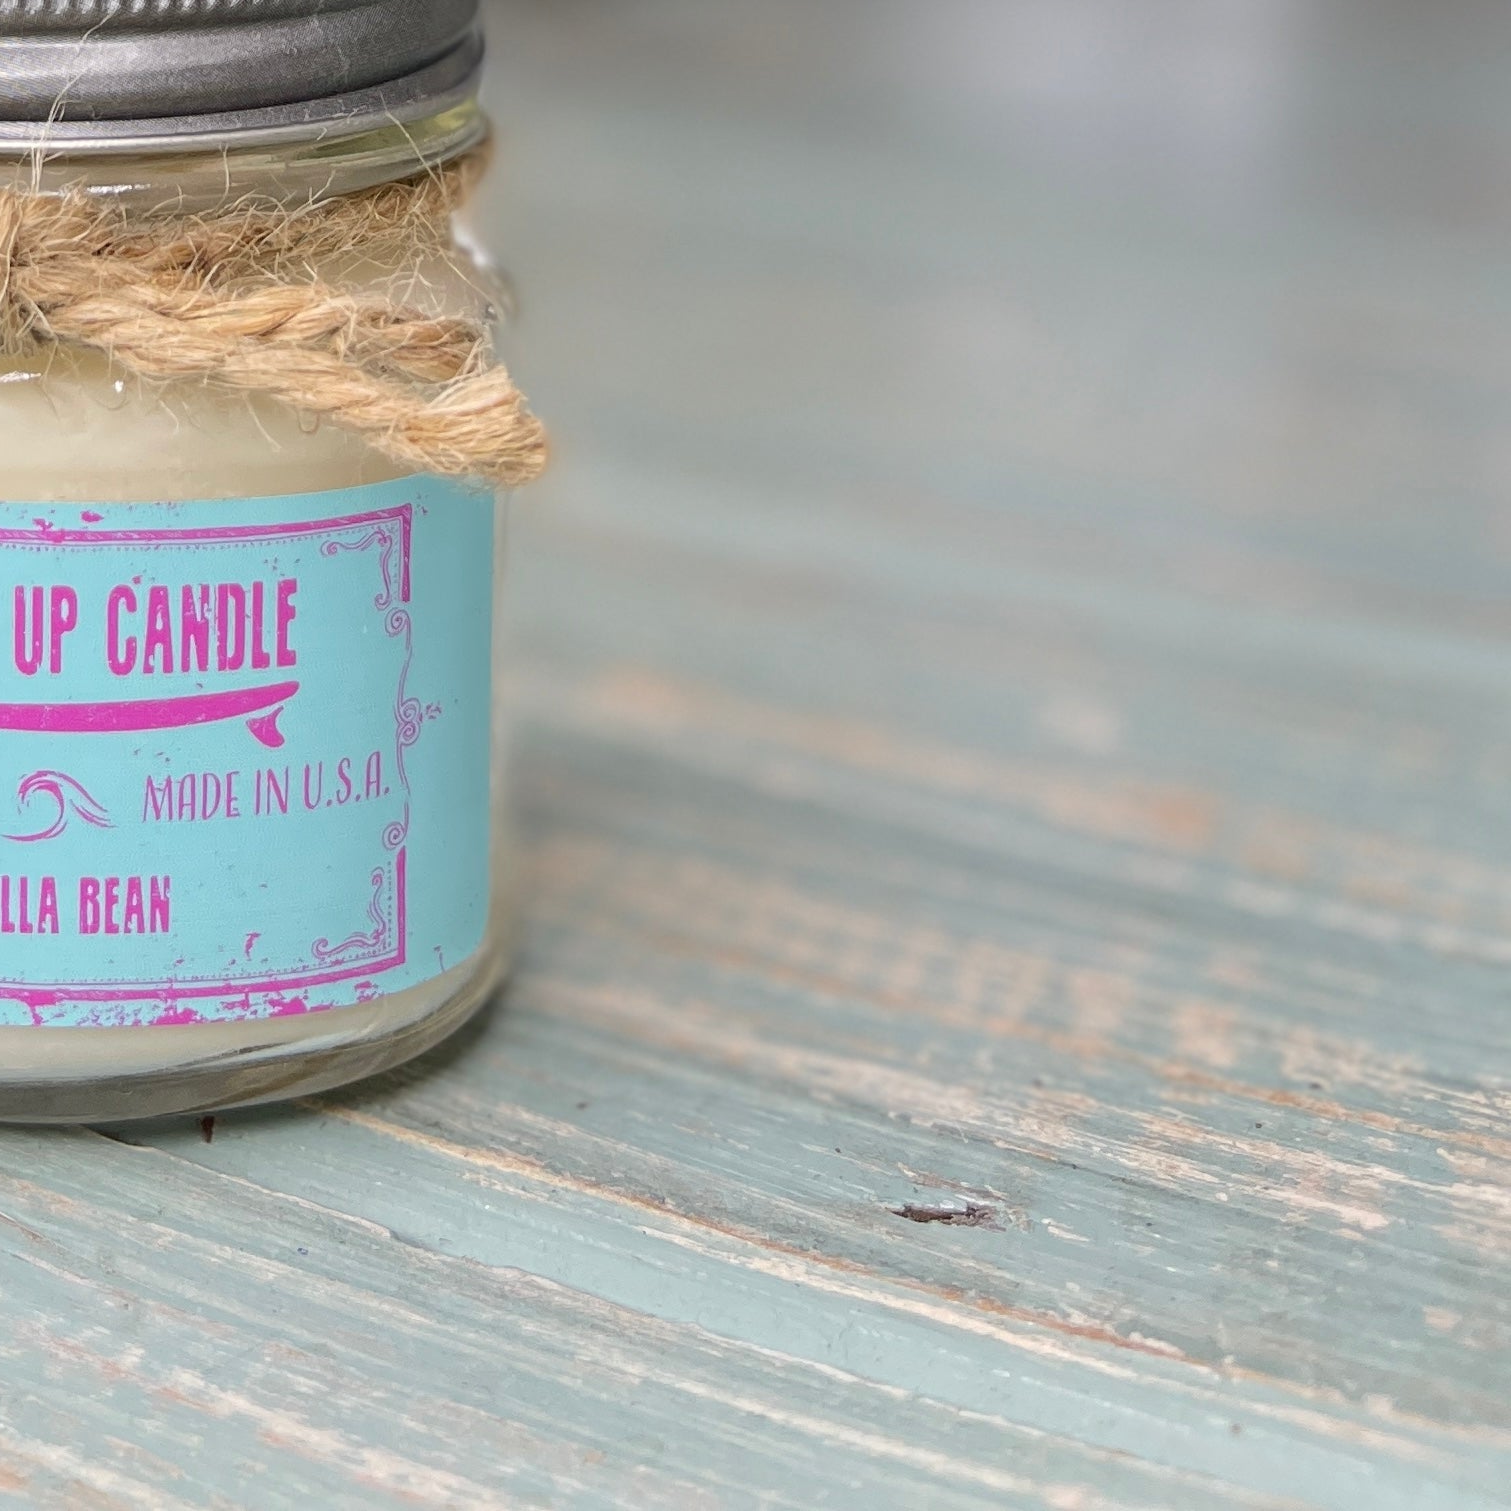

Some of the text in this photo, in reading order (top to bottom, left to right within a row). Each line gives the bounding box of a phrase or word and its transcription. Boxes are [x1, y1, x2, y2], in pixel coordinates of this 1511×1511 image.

[13, 584, 79, 677] UP
[106, 579, 299, 677] CANDLE
[143, 750, 391, 822] MADE IN U.S.A.
[78, 876, 172, 936] BEAN
